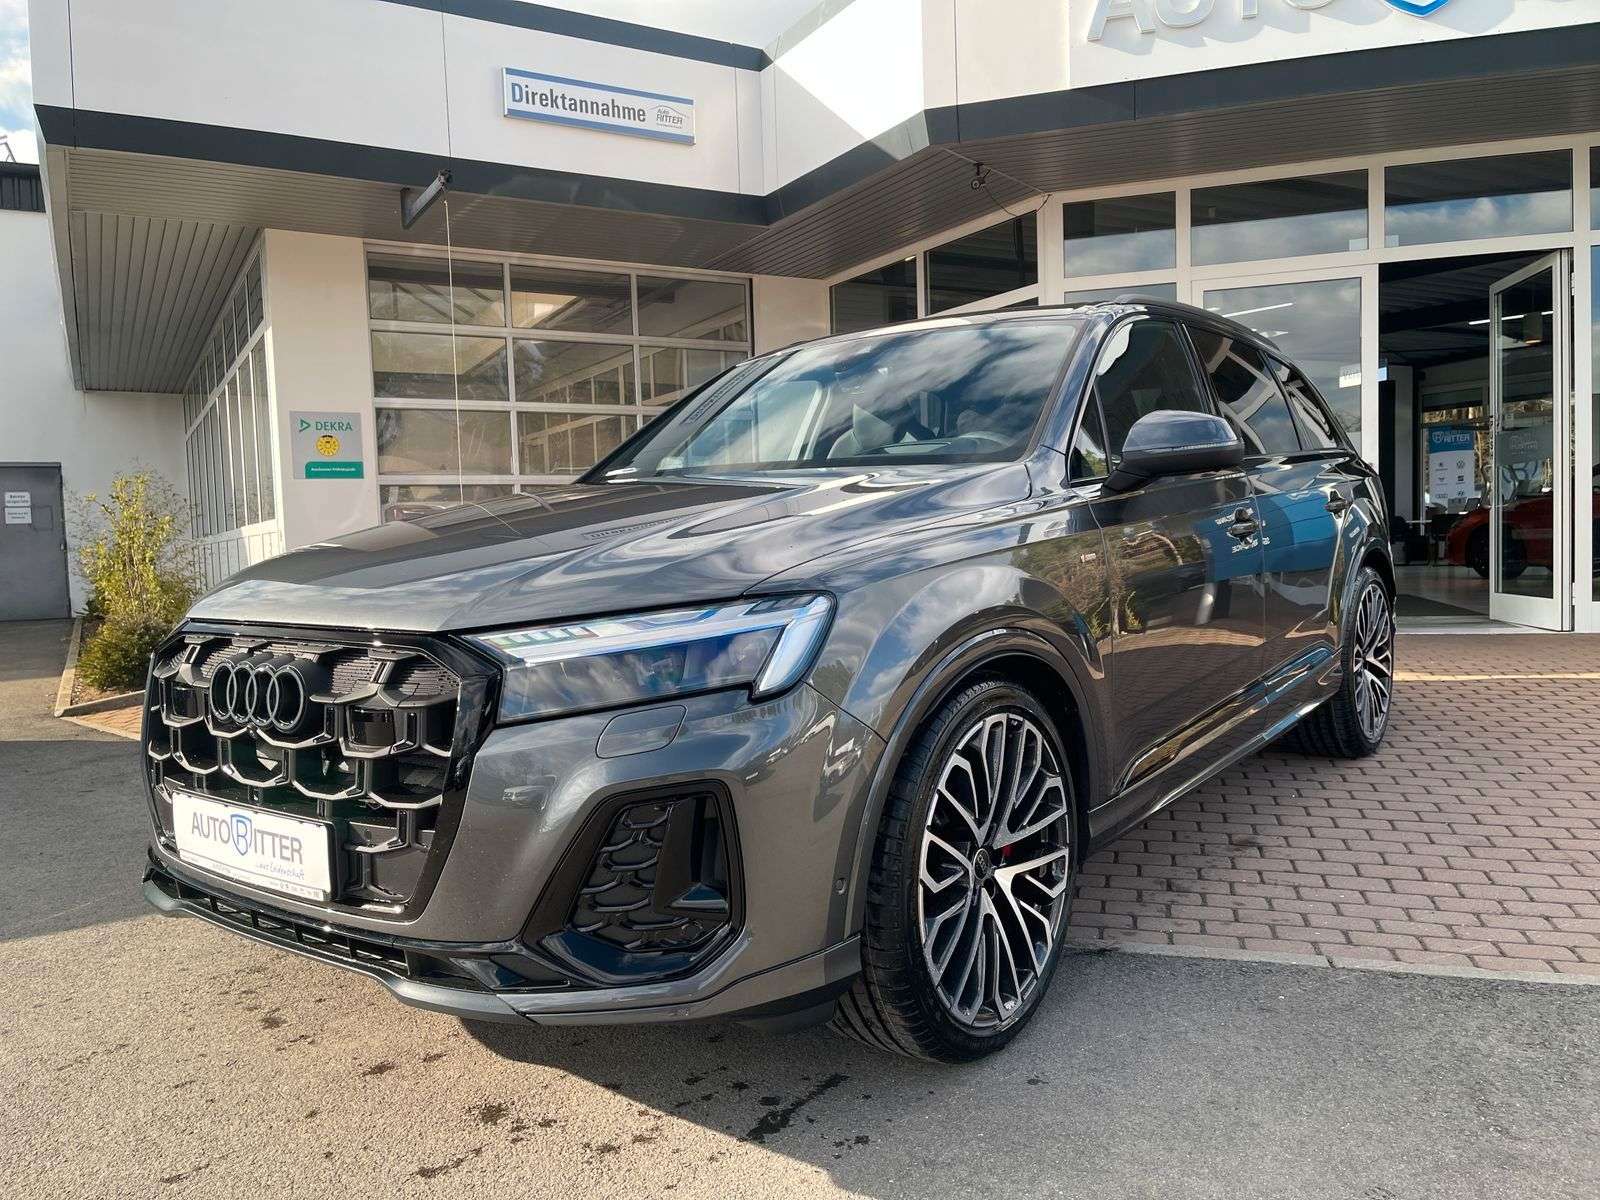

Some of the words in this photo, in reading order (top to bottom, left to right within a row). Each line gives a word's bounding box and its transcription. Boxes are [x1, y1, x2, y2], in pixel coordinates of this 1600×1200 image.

[511, 82, 646, 122] Direktannahme
[657, 114, 682, 125] RITTER
[315, 421, 353, 431] DEKRA
